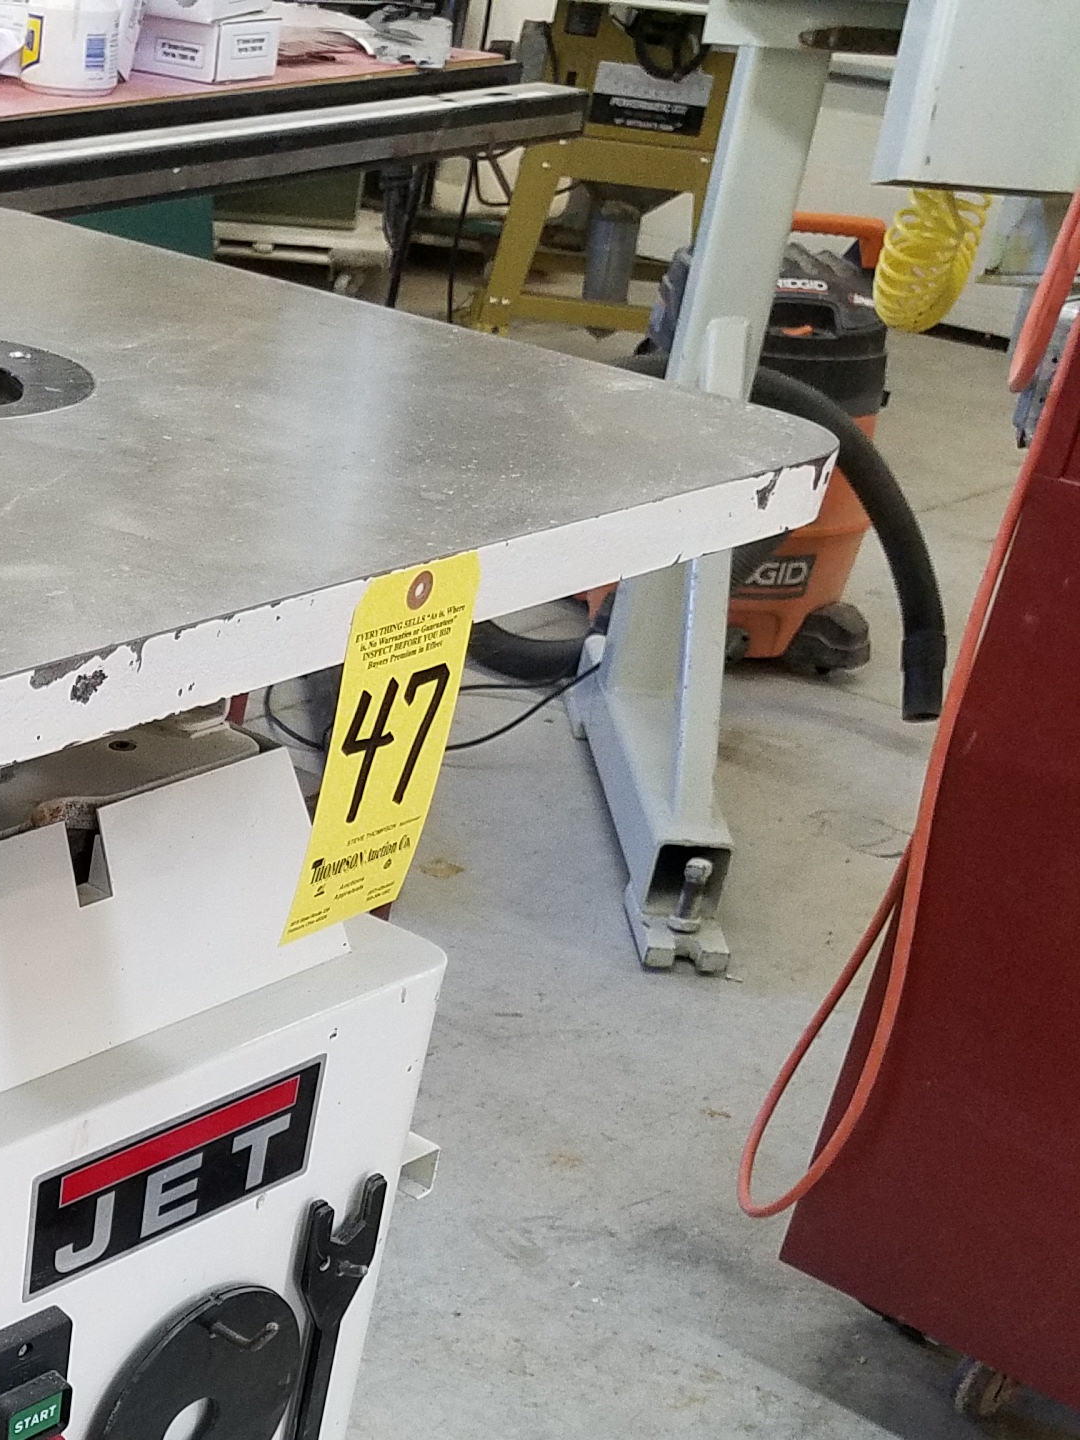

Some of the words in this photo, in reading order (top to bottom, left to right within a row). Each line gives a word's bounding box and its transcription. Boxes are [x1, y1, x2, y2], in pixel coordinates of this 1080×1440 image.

[356, 622, 403, 643] EVERYTHING
[404, 615, 426, 629] SELLS
[446, 604, 466, 615] Where
[368, 640, 377, 649] No
[379, 630, 412, 646] Warranties
[413, 628, 420, 636] or
[362, 644, 393, 661] INSPECT
[394, 636, 423, 652] BEFORE
[423, 630, 438, 643] YOU
[439, 626, 452, 639] BID
[367, 657, 389, 670] Buyers
[389, 649, 417, 663] Premium
[418, 646, 424, 654] in
[341, 662, 450, 824] 47
[346, 833, 366, 847] STEVE
[54, 1112, 292, 1274] JET
[14, 1404, 57, 1434] START
